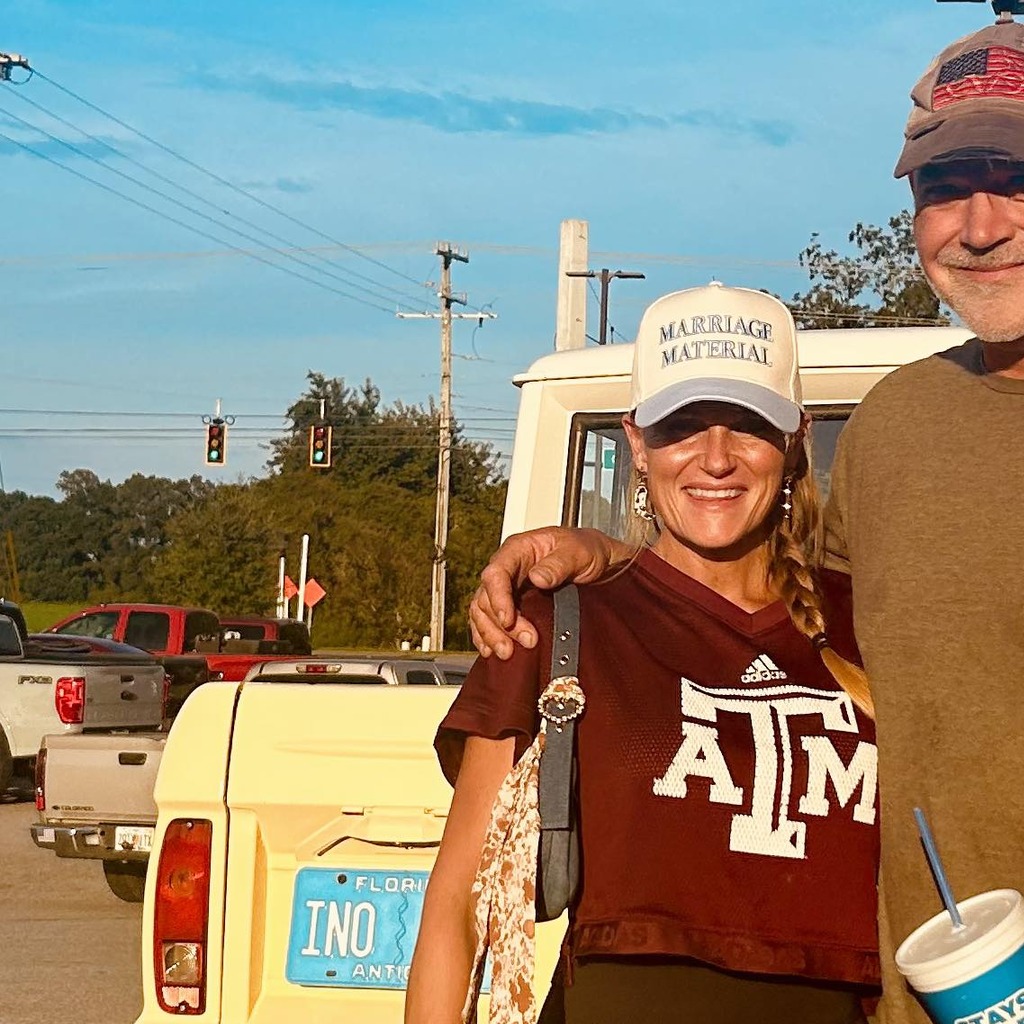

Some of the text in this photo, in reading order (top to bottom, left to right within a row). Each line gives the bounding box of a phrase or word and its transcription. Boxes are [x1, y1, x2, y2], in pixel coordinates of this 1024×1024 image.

[659, 314, 773, 344] MARRIAGE
[661, 340, 773, 368] MATERIAL
[741, 670, 787, 683] adidas
[355, 876, 428, 893] FLORI
[352, 964, 411, 980] ANTI
